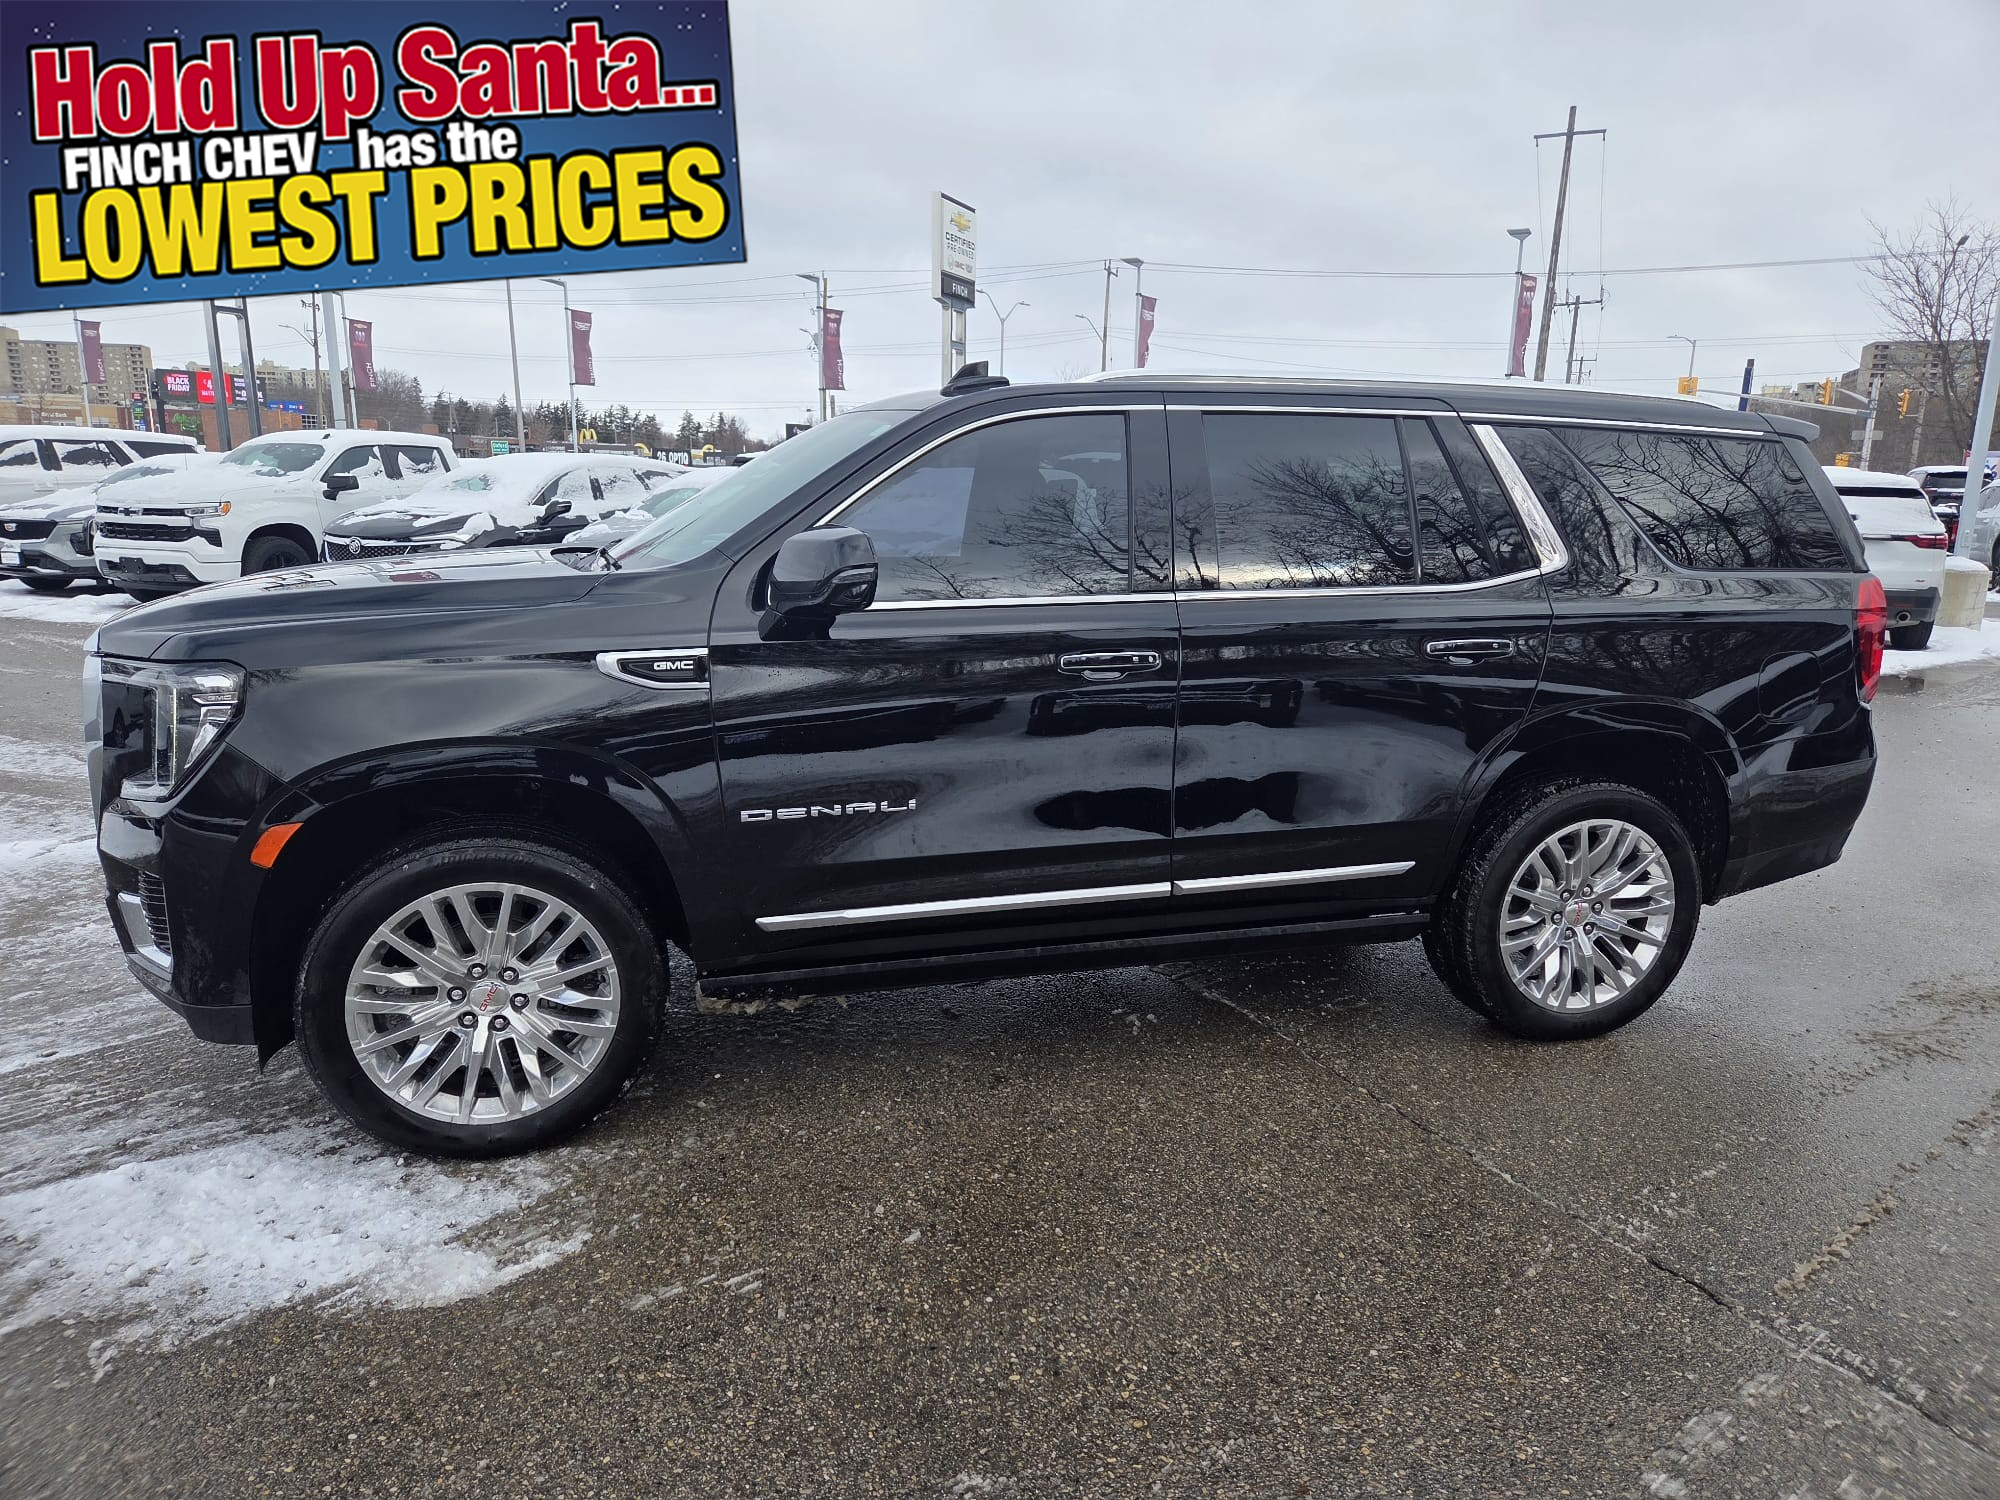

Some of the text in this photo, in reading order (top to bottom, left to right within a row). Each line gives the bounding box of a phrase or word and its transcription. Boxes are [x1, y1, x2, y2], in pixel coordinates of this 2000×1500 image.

[945, 231, 976, 251] CERTIFIED
[952, 283, 969, 297] FINCH
[167, 376, 190, 386] BLACK
[366, 362, 377, 388] FINCH
[167, 384, 191, 393] FRIDAY
[653, 660, 695, 671] GMC
[740, 798, 917, 823] DENALI
[479, 984, 499, 1012] GMC
